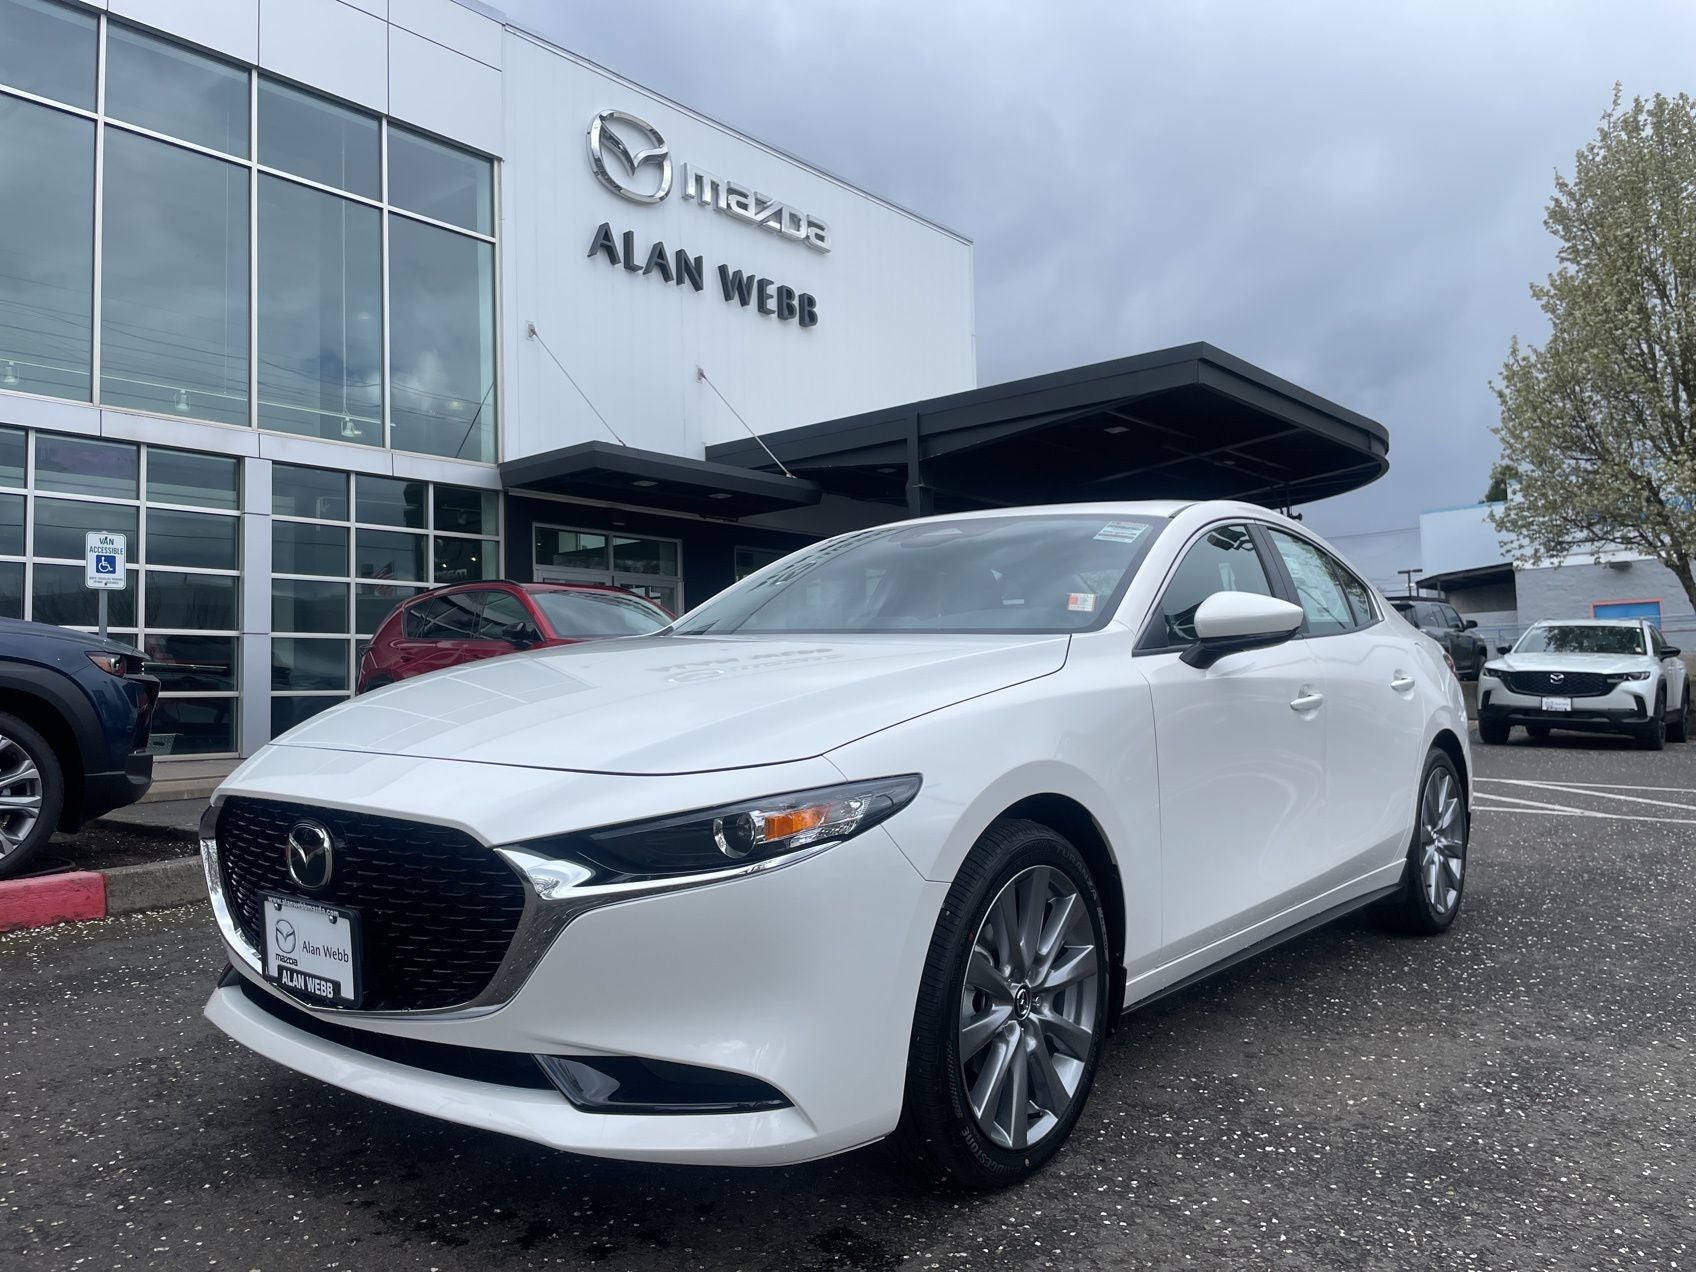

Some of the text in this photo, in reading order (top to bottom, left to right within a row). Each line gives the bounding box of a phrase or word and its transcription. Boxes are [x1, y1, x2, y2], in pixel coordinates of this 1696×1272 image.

[587, 221, 819, 328] ALAN WEBB
[99, 537, 114, 545] VAN
[89, 545, 124, 556] ACCESSIBLE
[275, 953, 298, 966] mazda
[302, 940, 349, 963] Alan Webb
[281, 969, 334, 998] ALAN WEBB
